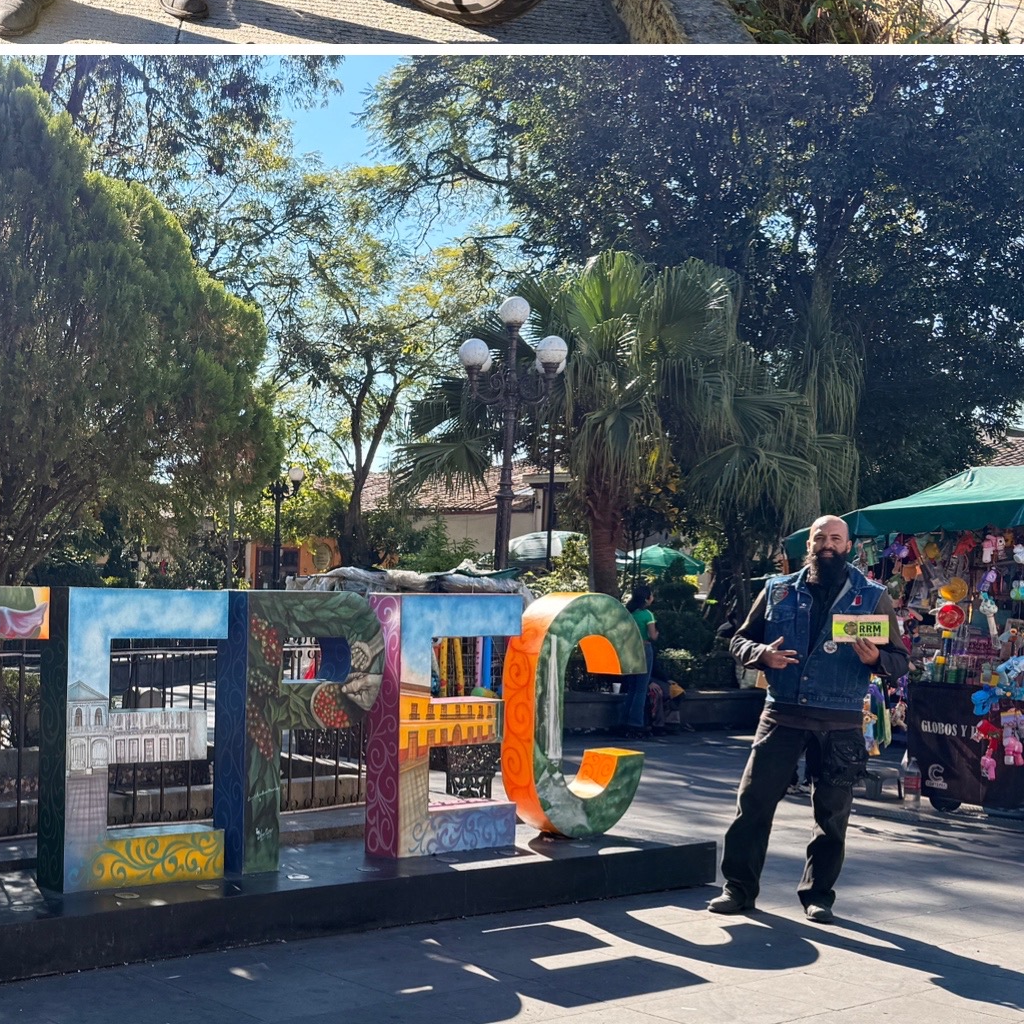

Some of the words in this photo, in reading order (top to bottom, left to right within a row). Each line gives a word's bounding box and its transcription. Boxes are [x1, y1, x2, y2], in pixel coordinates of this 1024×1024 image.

[859, 625, 881, 633] RRM
[921, 720, 957, 736] GLOBOS
[961, 725, 967, 737] Y
